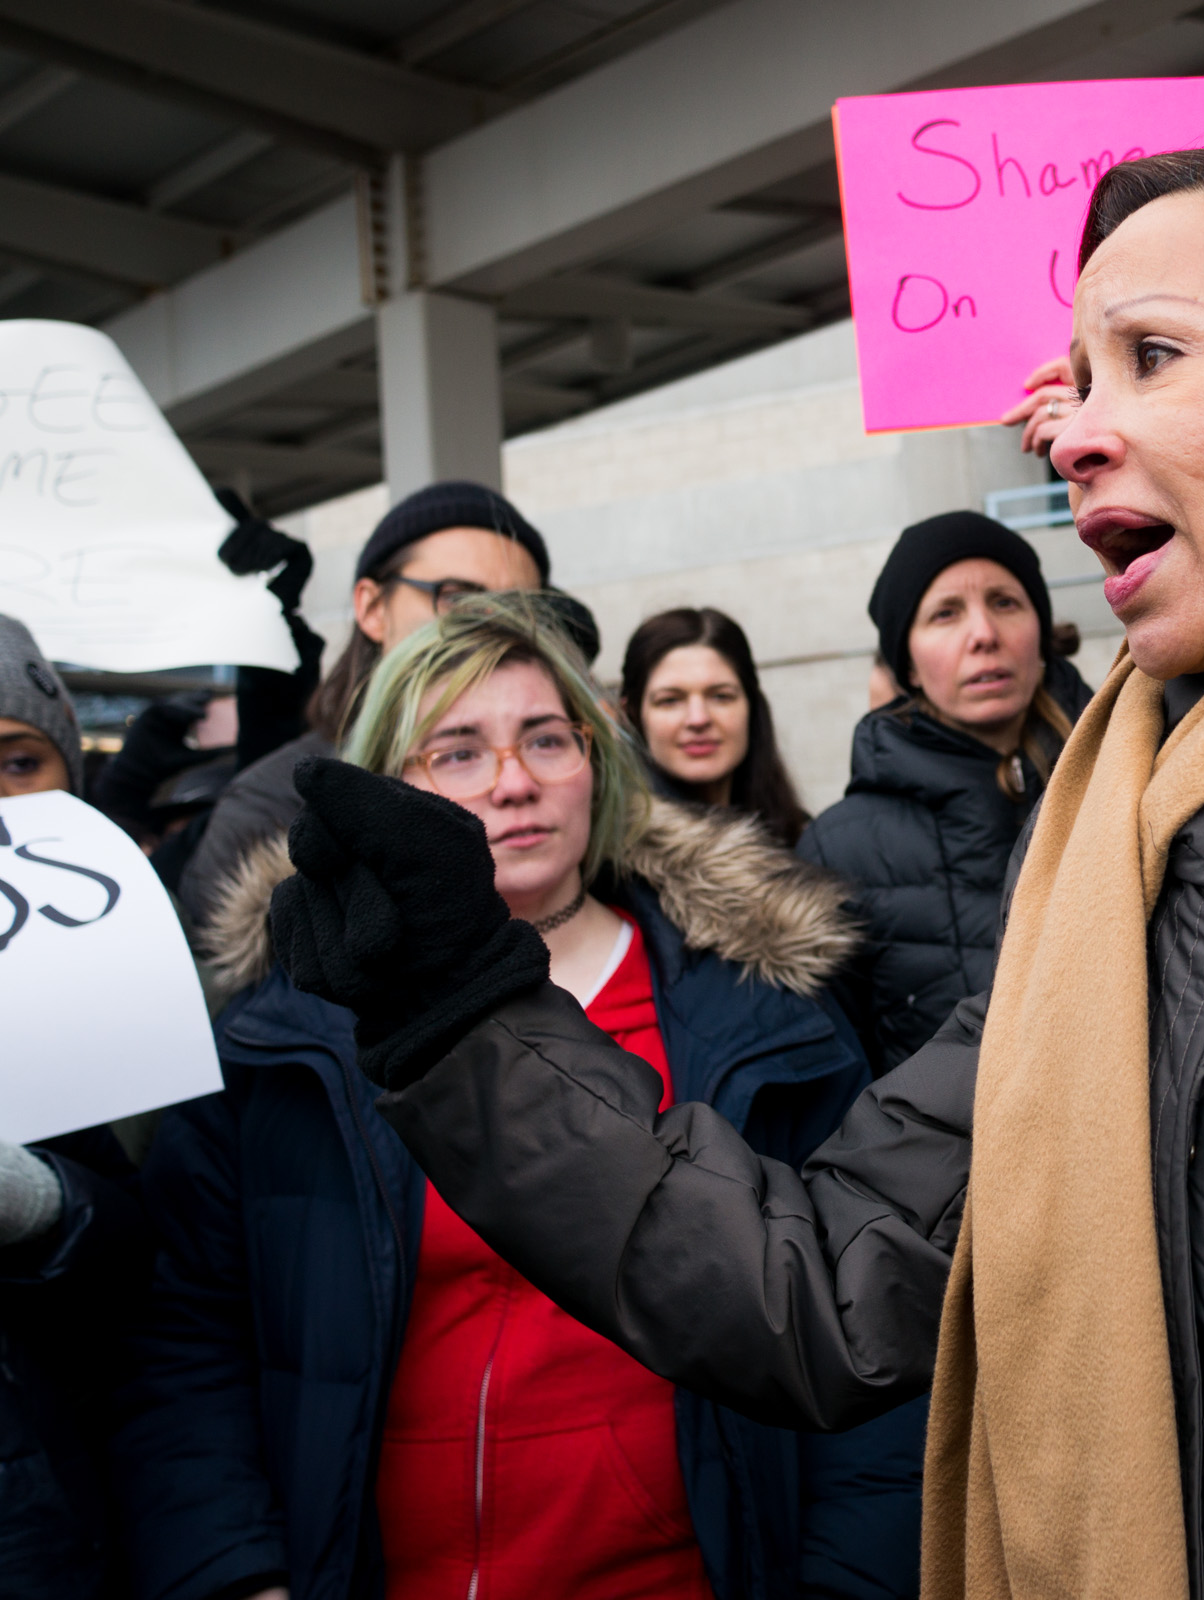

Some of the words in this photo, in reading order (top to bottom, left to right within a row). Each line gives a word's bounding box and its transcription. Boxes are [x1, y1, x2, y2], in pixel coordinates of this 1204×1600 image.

[897, 118, 1146, 212] Sham
[892, 274, 977, 332] On
[0, 364, 152, 434] EE
